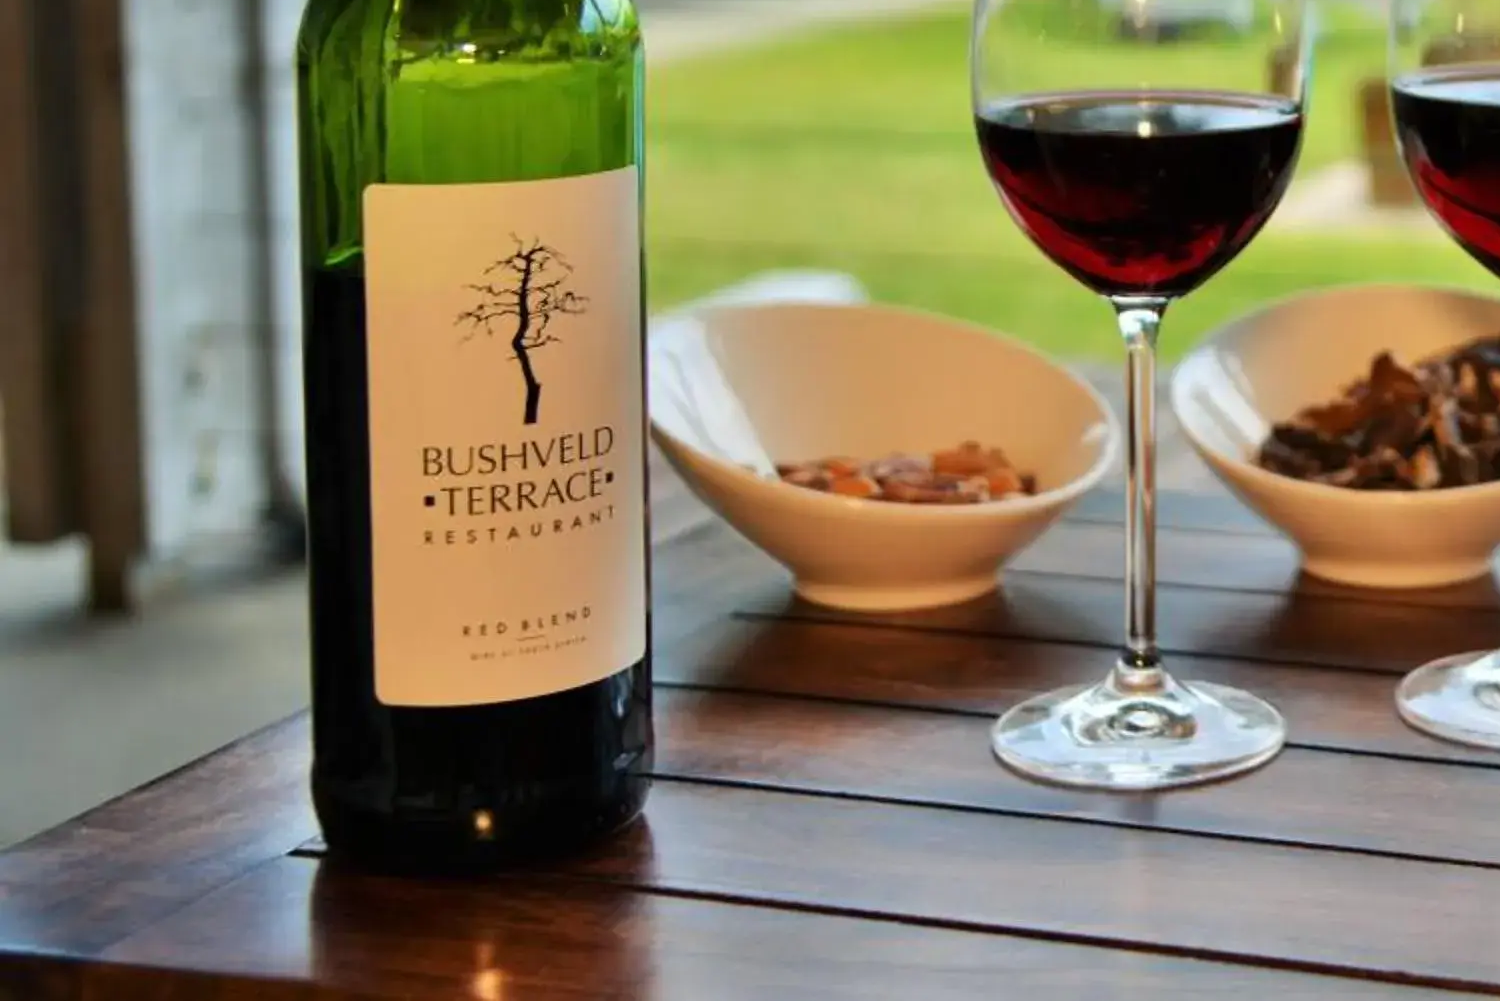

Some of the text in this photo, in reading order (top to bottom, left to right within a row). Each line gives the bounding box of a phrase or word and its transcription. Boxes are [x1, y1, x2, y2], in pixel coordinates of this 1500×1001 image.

[423, 426, 613, 476] BUSHVELD
[440, 468, 602, 515] TERRACE
[424, 505, 613, 544] RESTAURANT
[462, 606, 591, 636] RED BLEND
